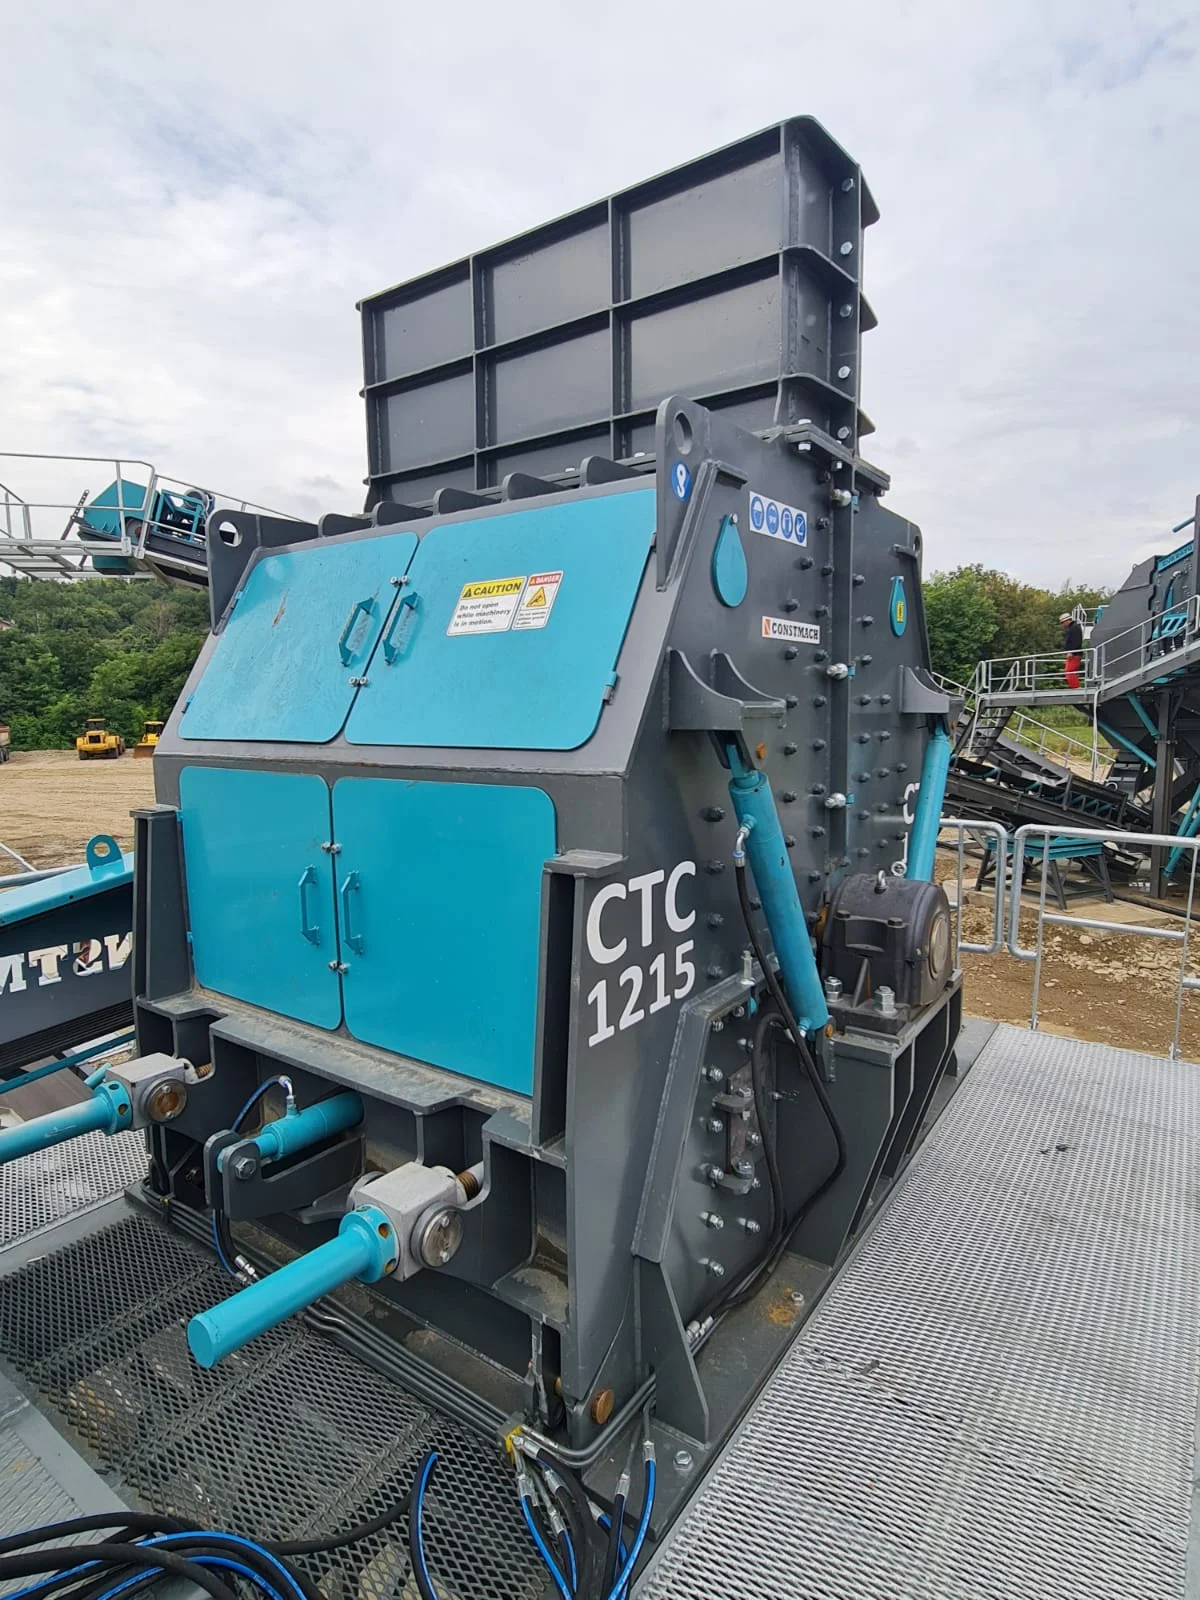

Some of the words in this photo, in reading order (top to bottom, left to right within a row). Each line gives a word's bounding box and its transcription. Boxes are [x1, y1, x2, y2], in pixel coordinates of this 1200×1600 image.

[535, 574, 561, 584] DANGER
[473, 582, 522, 596] CAUTION
[482, 602, 499, 611] open
[456, 611, 474, 619] while
[475, 609, 511, 618] machinery
[771, 622, 819, 640] CONSTMACH
[586, 860, 696, 964] CTC
[587, 939, 696, 1047] 1215
